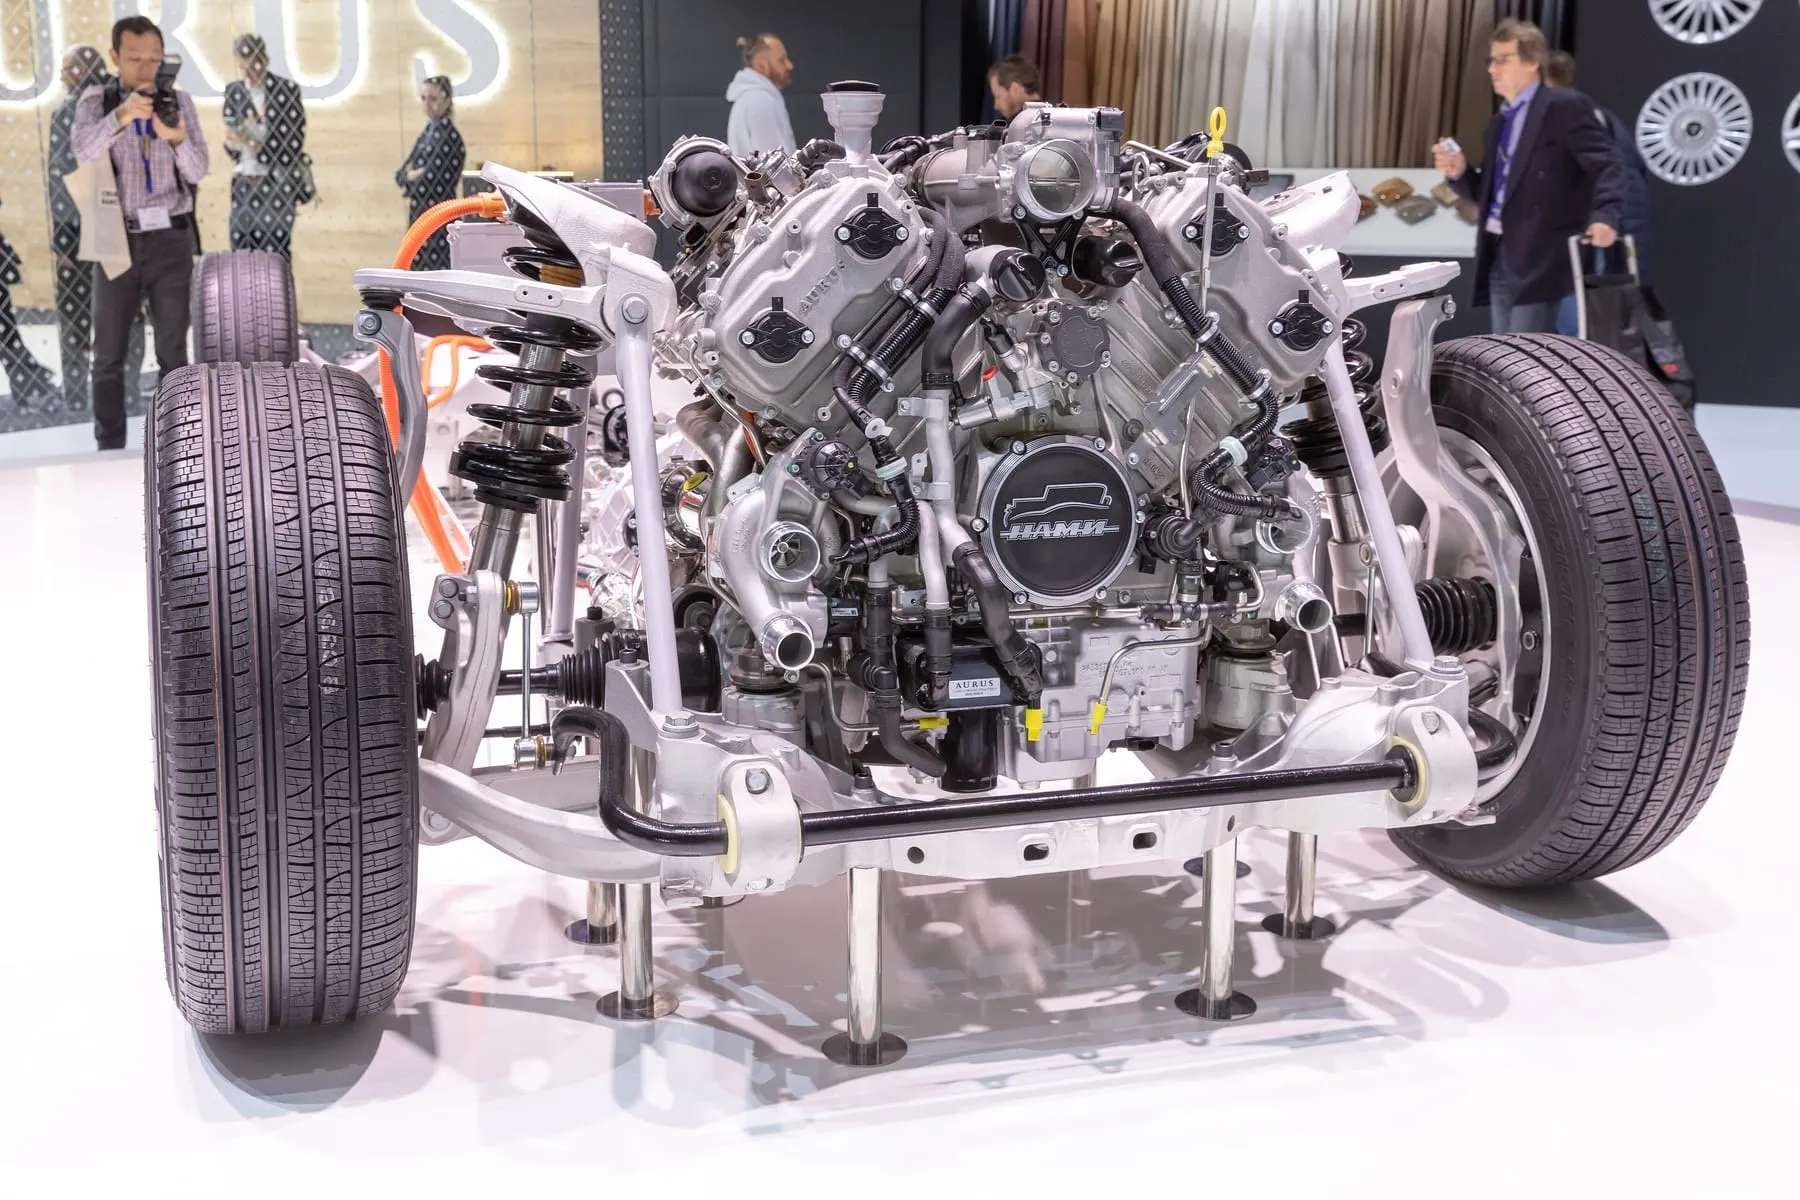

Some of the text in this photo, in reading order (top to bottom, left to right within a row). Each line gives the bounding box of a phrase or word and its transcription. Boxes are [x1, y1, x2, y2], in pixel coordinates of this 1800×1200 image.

[800, 259, 846, 313] AURUS
[1006, 520, 1109, 540] НАМИ
[955, 680, 994, 689] AURUS
